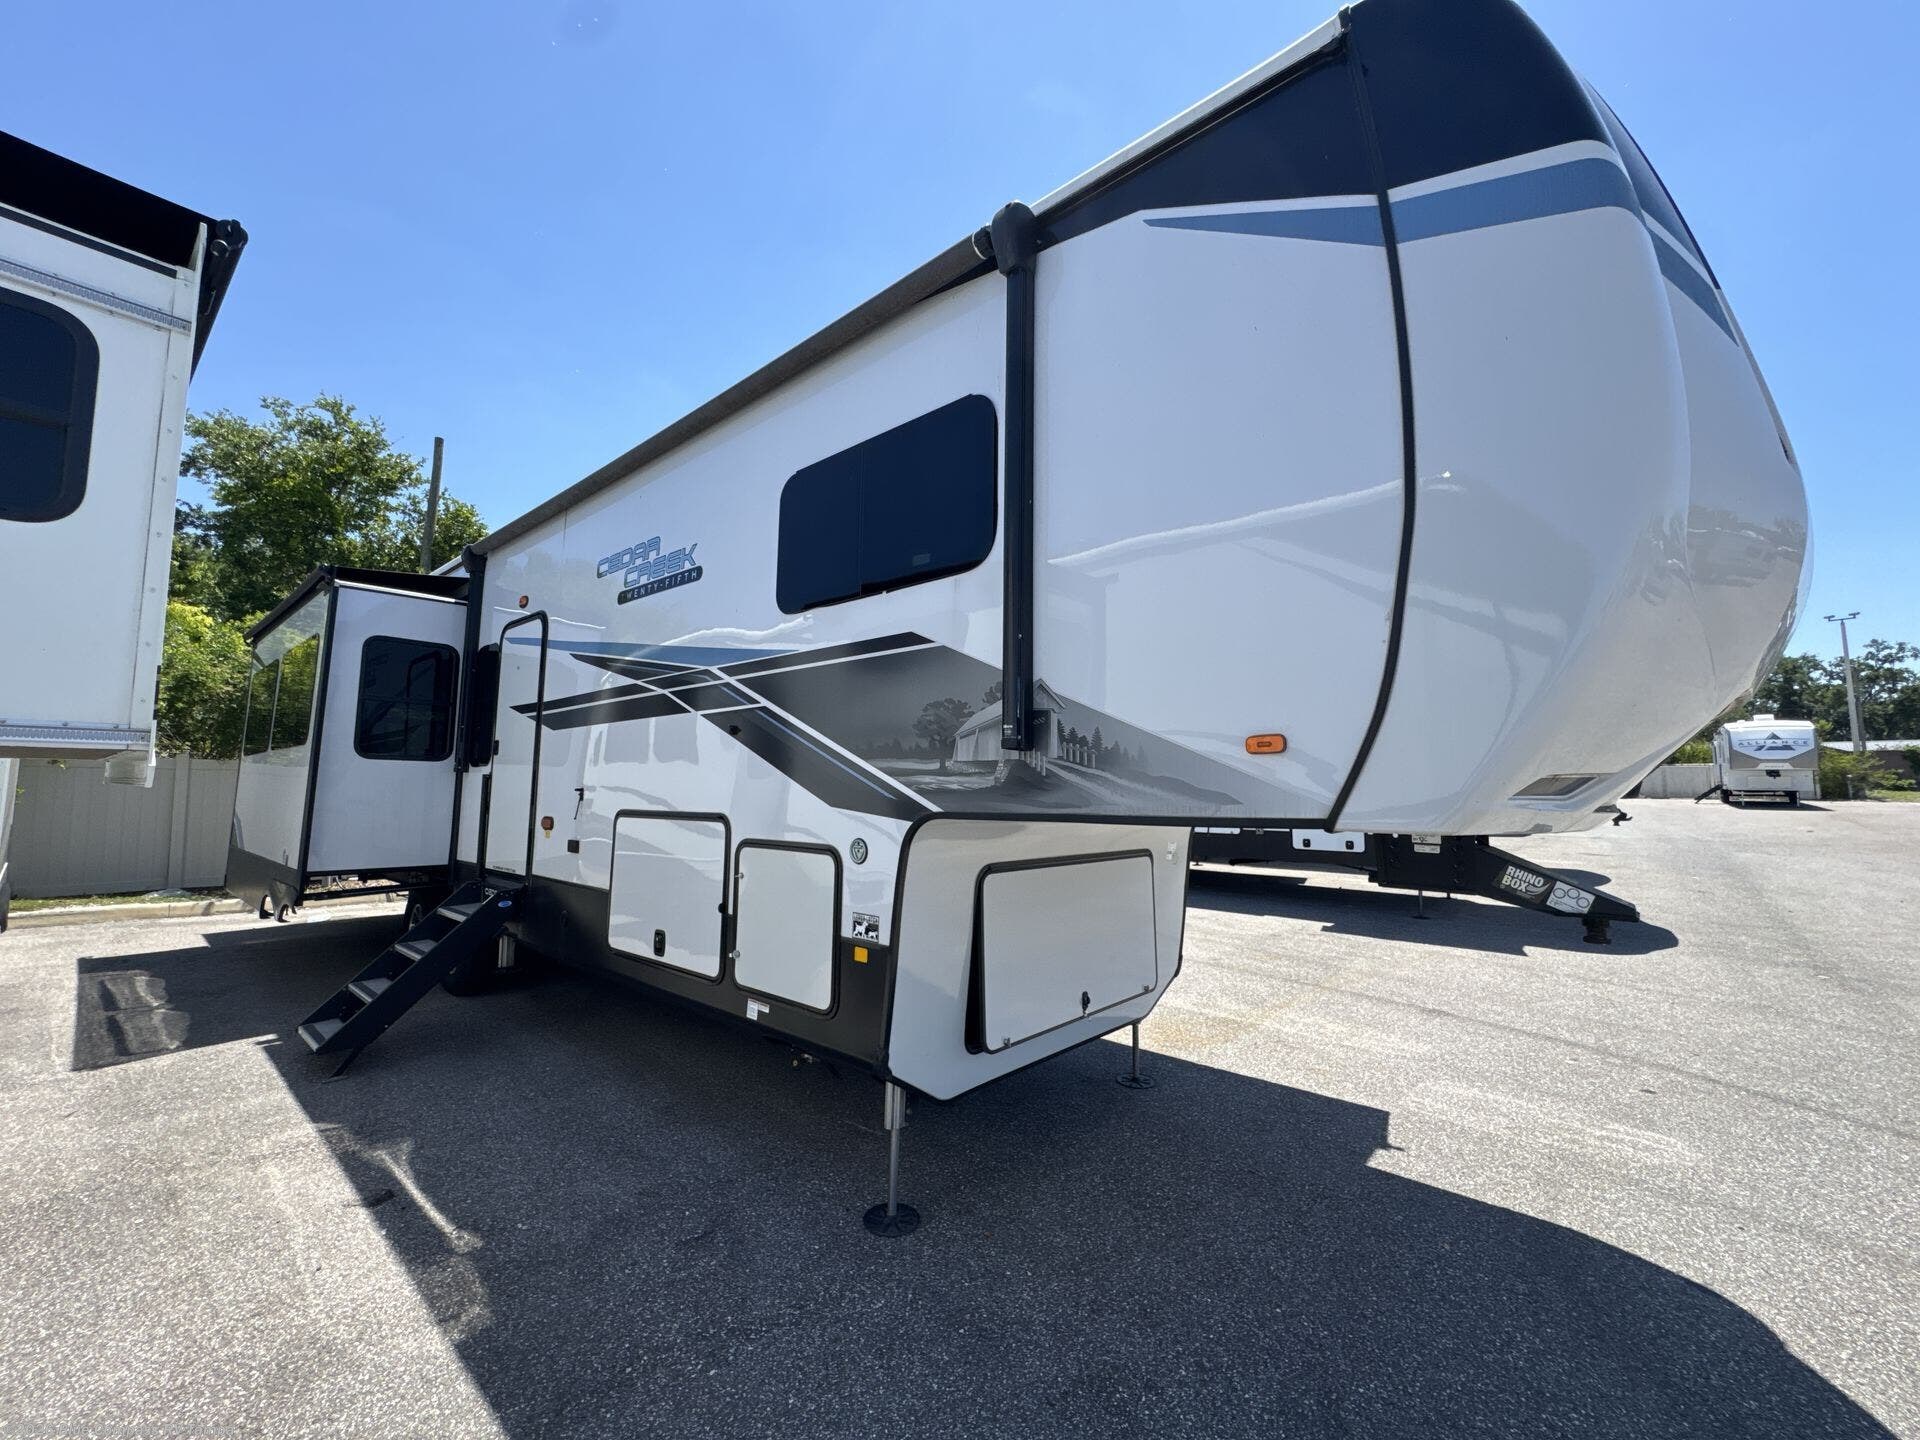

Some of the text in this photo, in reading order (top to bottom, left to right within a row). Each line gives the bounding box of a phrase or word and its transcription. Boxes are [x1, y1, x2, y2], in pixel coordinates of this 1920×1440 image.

[597, 536, 661, 579] CEDAR
[624, 543, 698, 588] CREEK
[620, 569, 698, 602] TWENTY-FIFTH
[1501, 875, 1528, 893] BOX
[1506, 865, 1544, 887] RHINO
